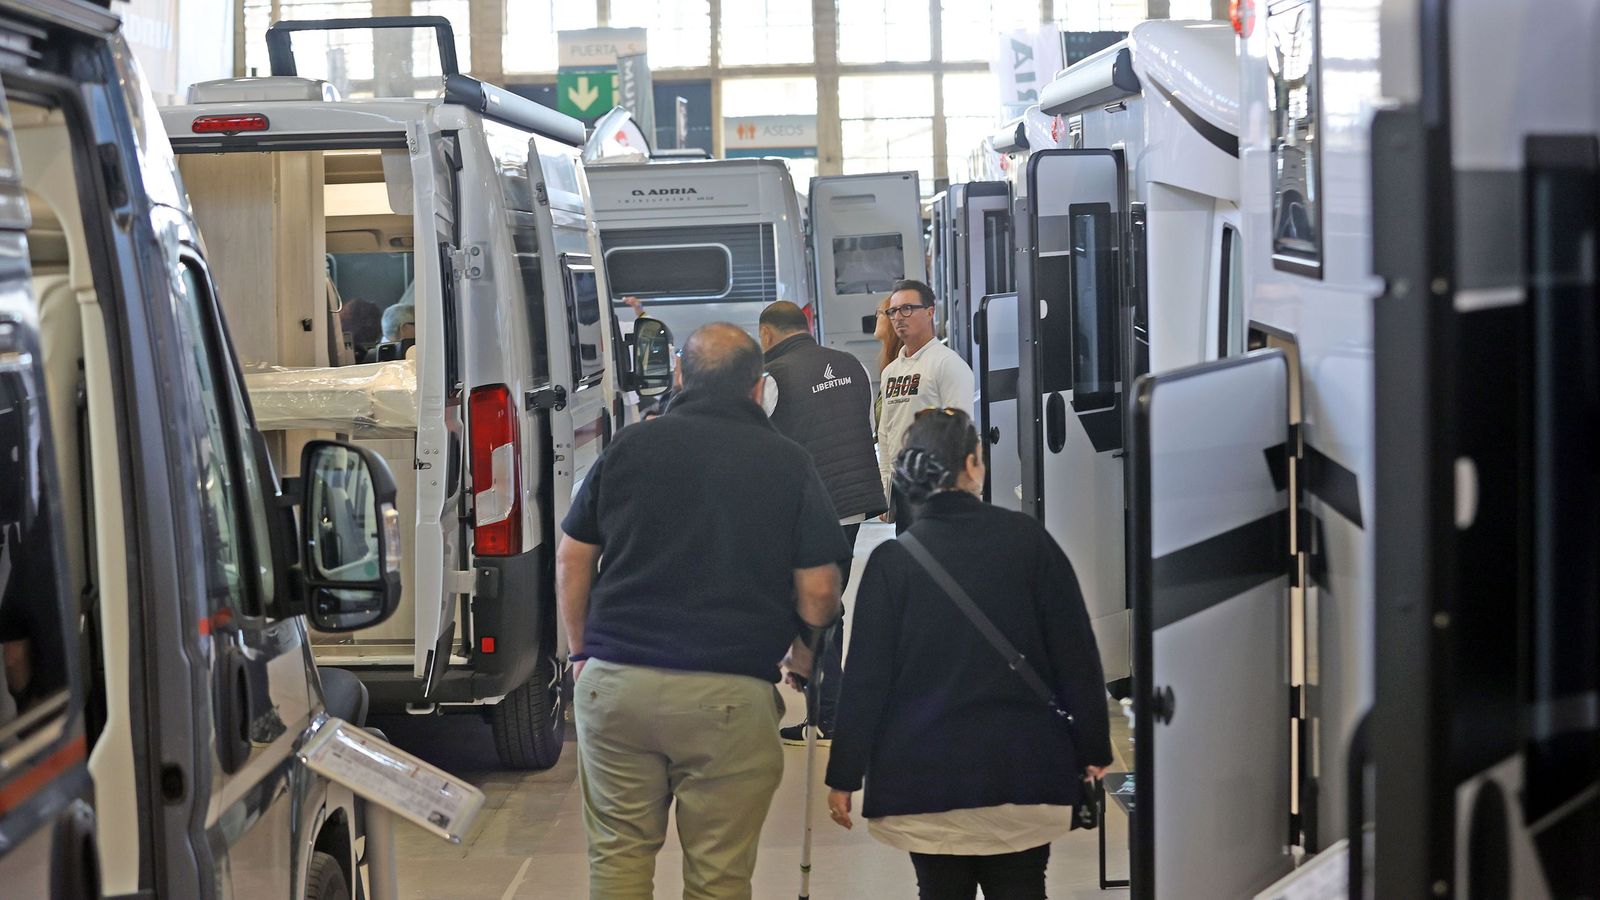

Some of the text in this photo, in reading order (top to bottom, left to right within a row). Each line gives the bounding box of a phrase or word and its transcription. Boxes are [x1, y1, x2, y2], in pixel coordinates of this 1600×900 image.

[570, 44, 618, 57] PUERTA
[763, 124, 804, 137] ASEOS
[812, 377, 852, 393] LIBERTIUM
